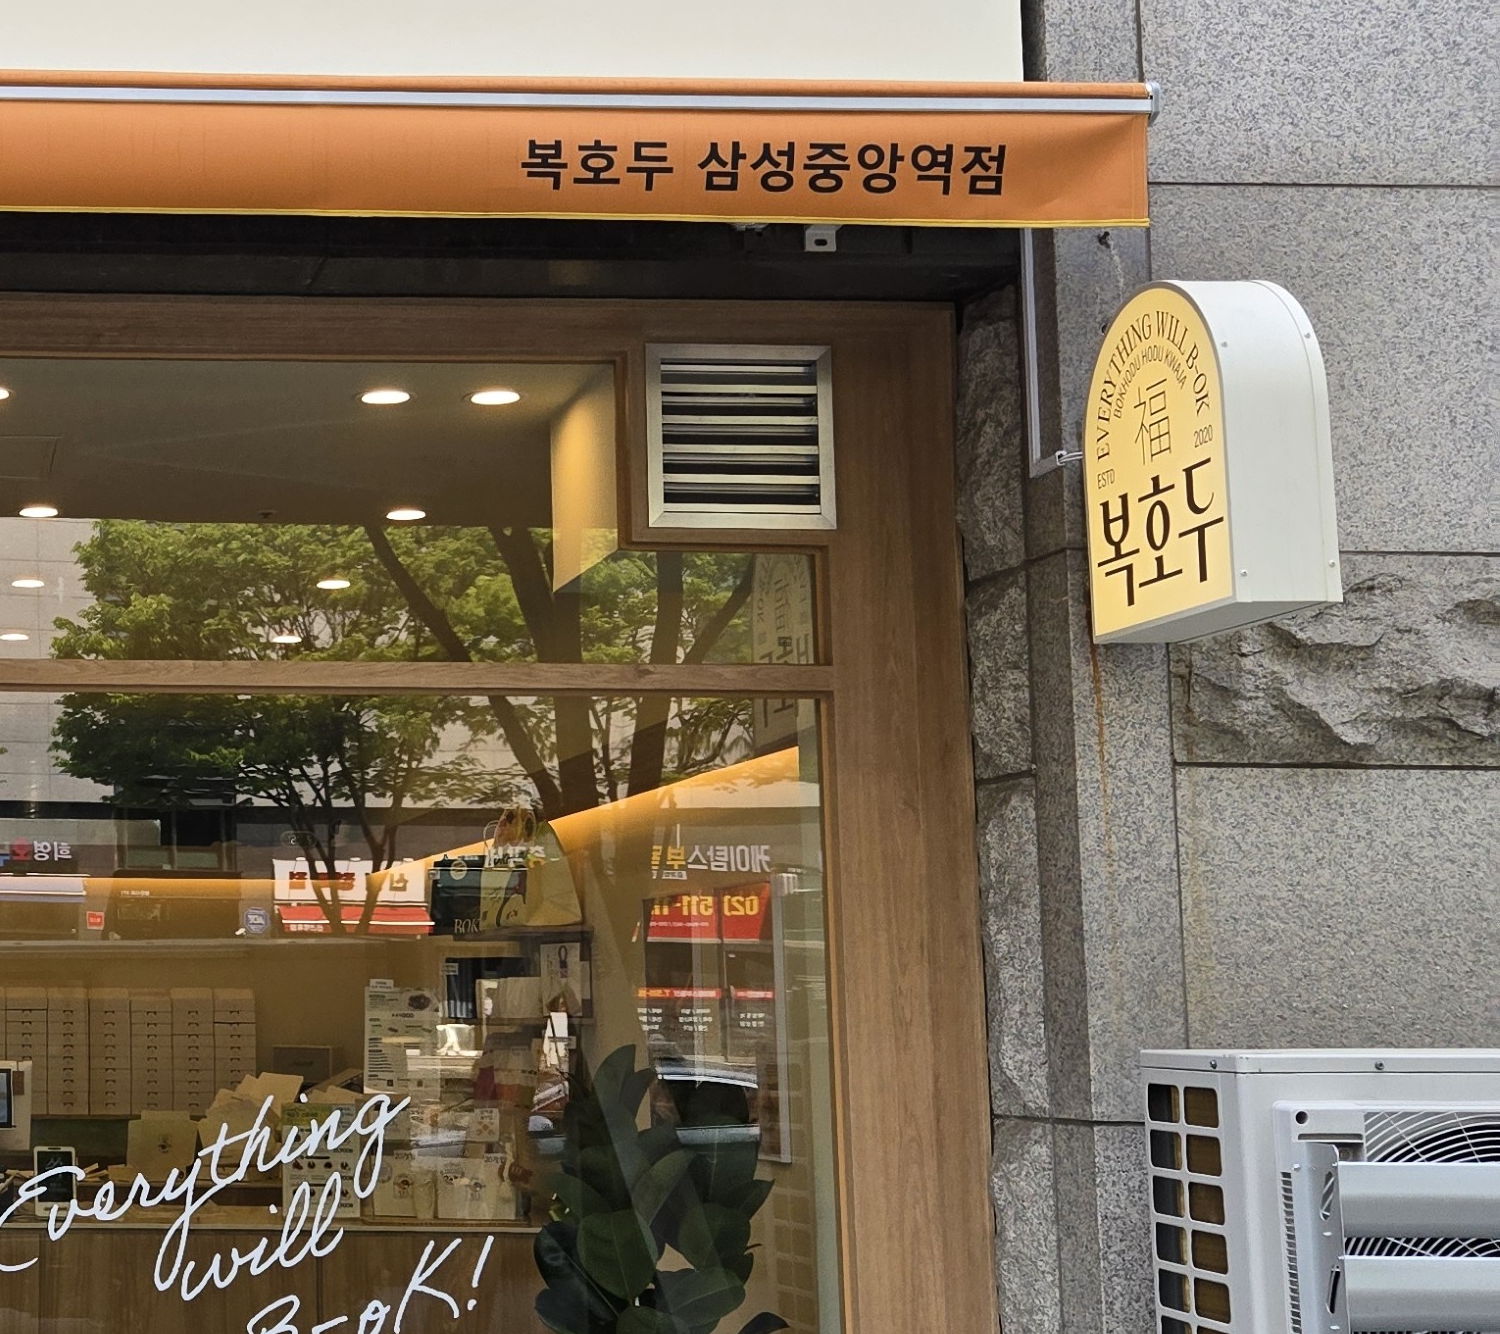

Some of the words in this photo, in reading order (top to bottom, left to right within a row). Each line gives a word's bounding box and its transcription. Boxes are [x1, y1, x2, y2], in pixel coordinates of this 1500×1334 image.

[519, 138, 674, 194] 복호두
[697, 140, 1008, 198] 삼성중앙역점
[1096, 313, 1153, 463] EVERYTHING
[1155, 310, 1189, 356] WILL
[1186, 342, 1211, 418] B-OK
[1113, 351, 1141, 419] BOKHODU
[1141, 344, 1164, 364] HODU
[1164, 348, 1188, 391] KWAJA
[1133, 378, 1172, 466] 福
[1097, 468, 1116, 490] ESTD
[1194, 424, 1214, 449] 2020
[1097, 457, 1225, 607] 복호두
[180, 1171, 345, 1302] will
